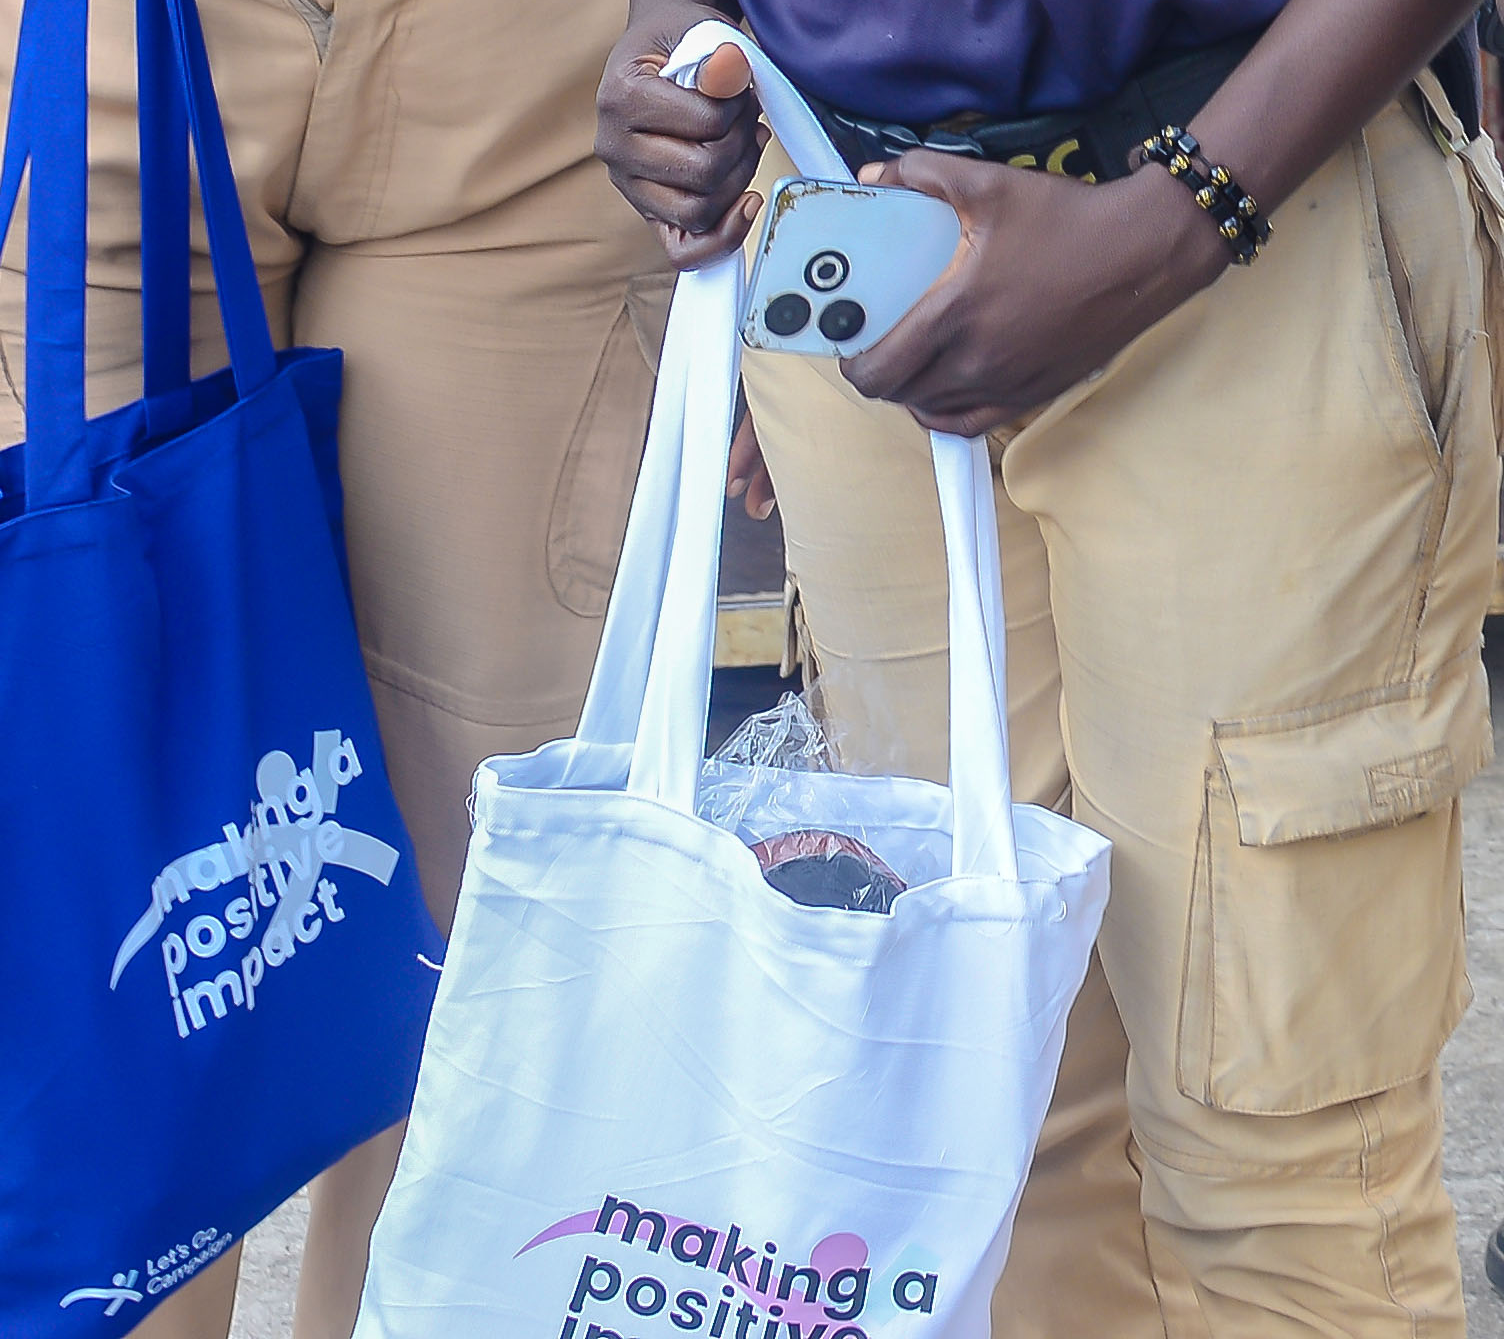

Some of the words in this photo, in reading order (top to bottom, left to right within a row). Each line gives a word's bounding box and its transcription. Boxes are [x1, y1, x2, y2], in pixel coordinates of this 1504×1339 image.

[328, 736, 363, 786] a
[161, 819, 346, 999] positive
[172, 877, 346, 1039] impact
[593, 1193, 872, 1321] making
[892, 1268, 939, 1315] a
